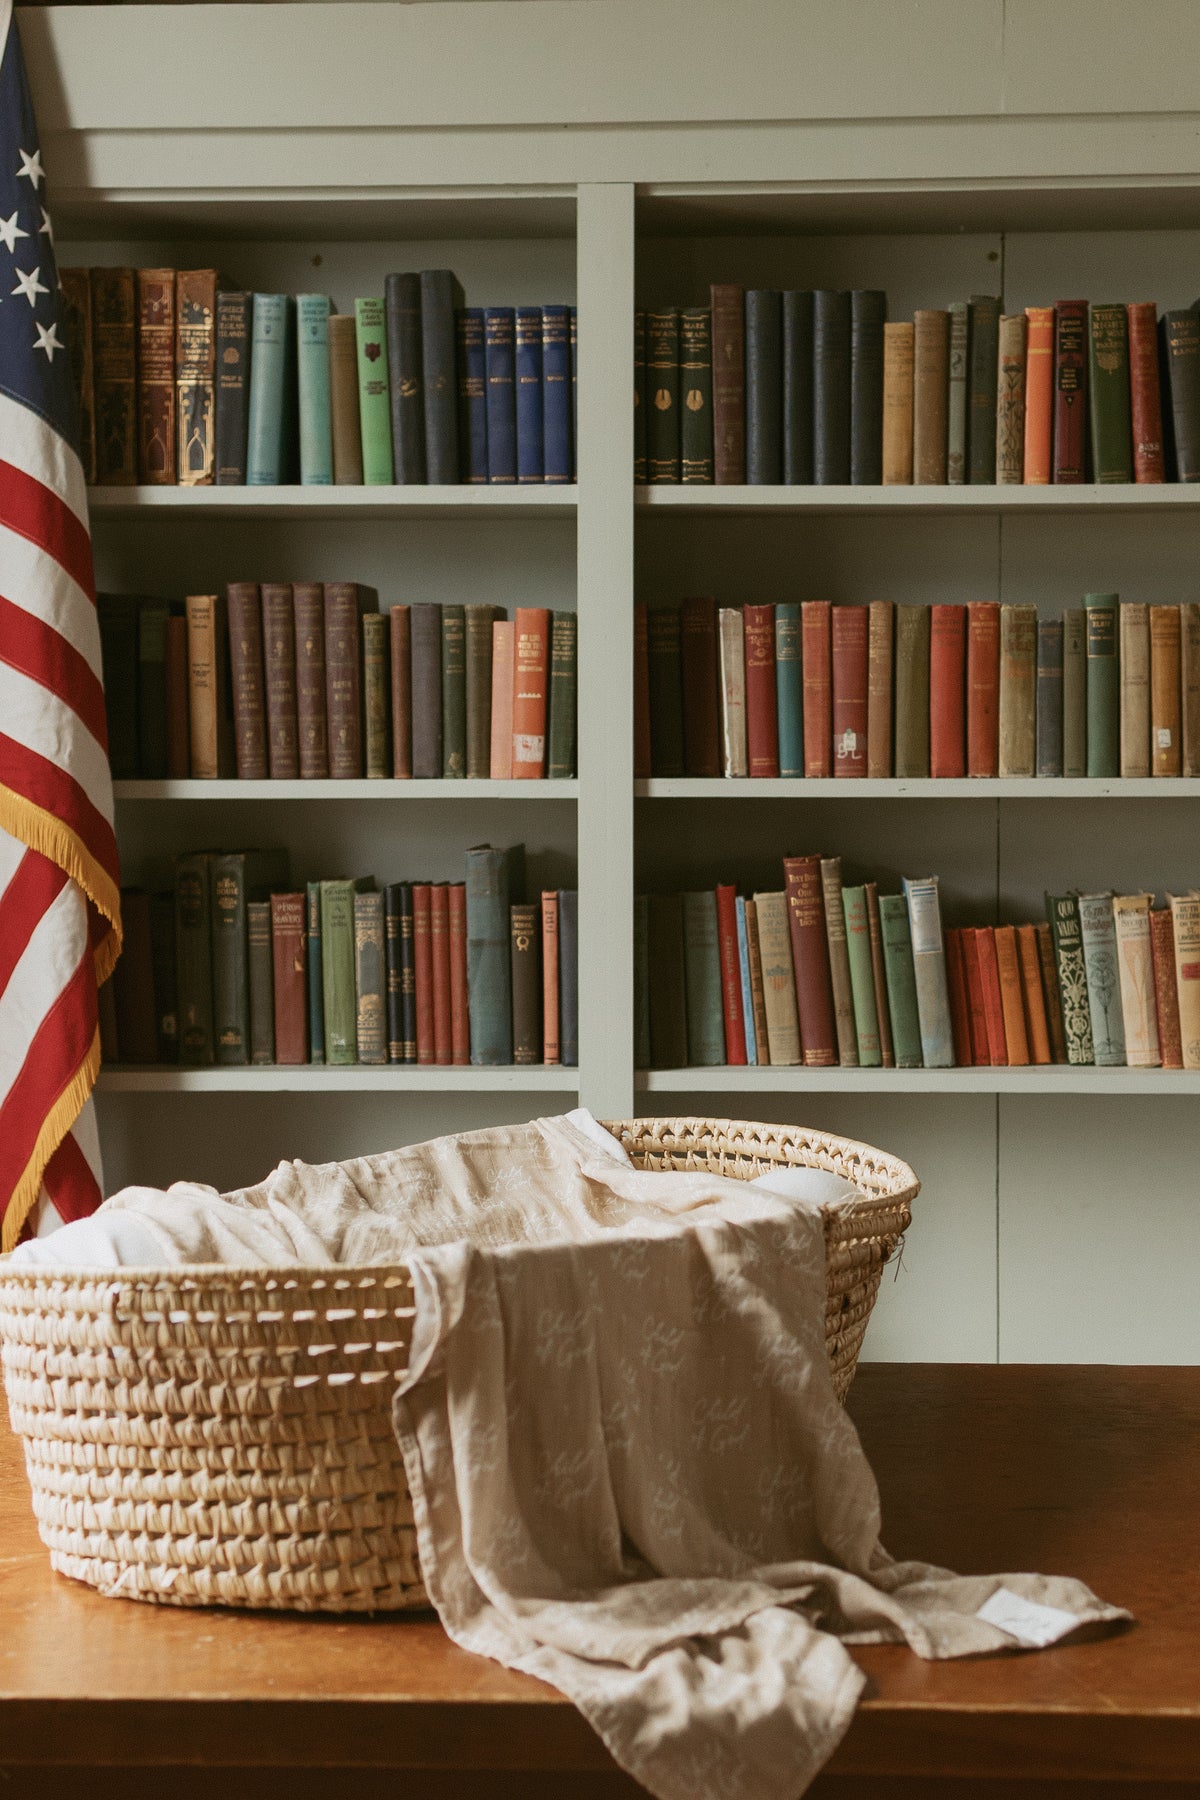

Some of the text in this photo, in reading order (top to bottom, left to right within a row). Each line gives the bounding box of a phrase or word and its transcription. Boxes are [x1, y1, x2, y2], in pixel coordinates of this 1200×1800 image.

[652, 321, 676, 329] MARK
[683, 322, 706, 330] MARK
[1057, 901, 1074, 919] QUO
[1055, 920, 1080, 937] VADIS
